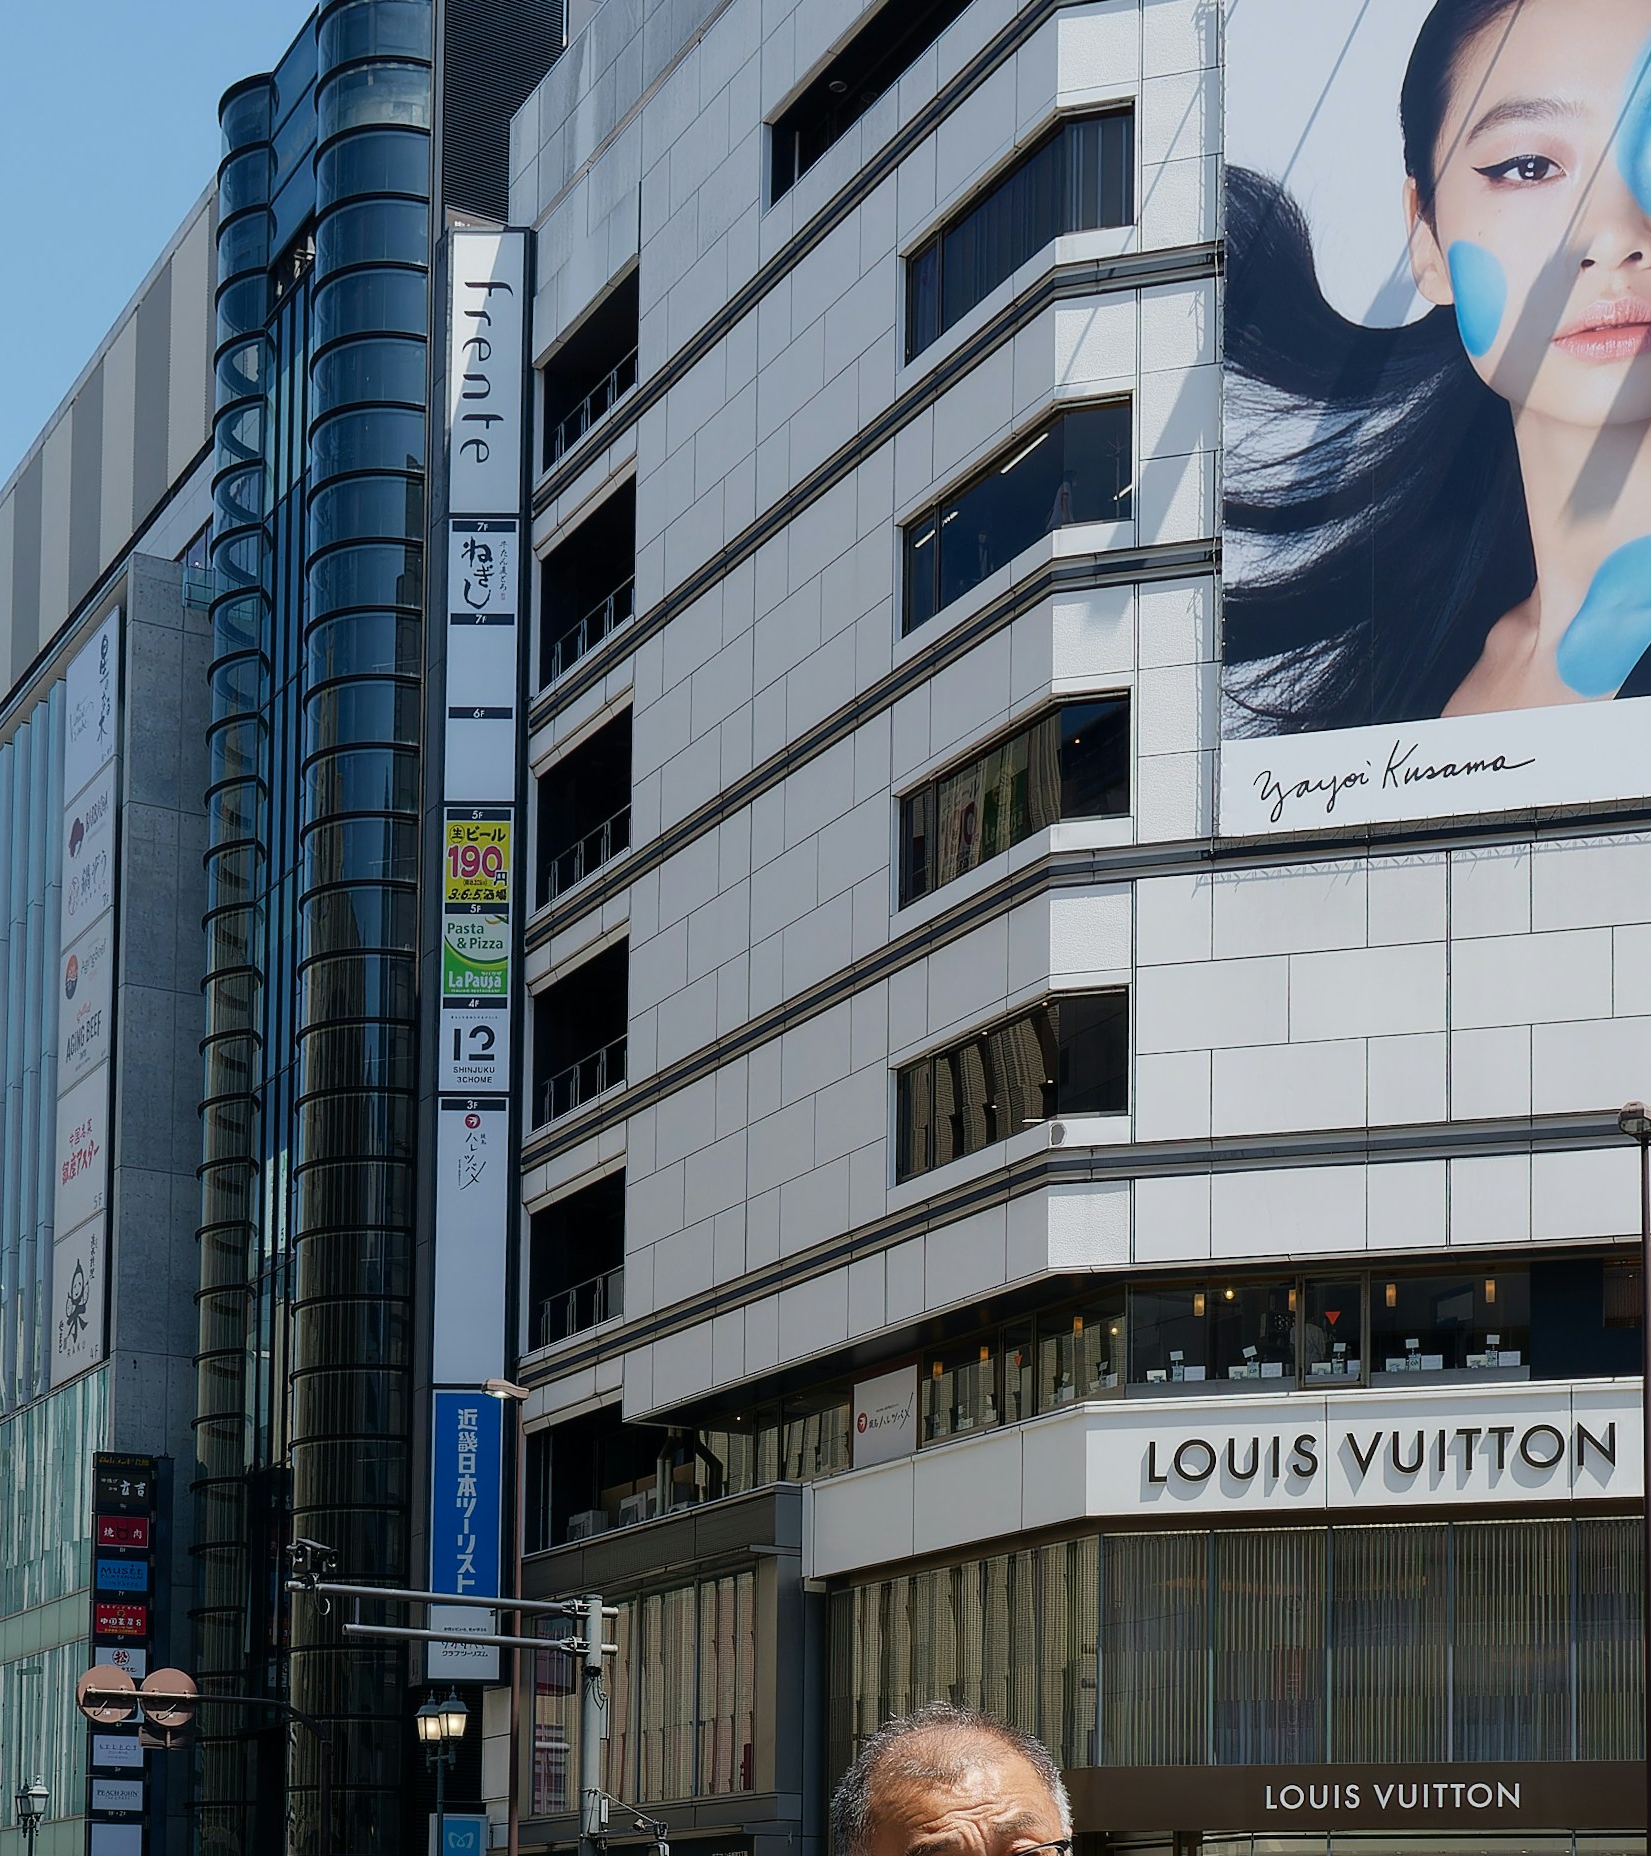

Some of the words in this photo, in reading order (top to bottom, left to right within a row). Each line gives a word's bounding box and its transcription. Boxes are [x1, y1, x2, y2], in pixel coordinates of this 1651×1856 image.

[459, 280, 514, 465] frente
[476, 522, 489, 531] 7F
[461, 536, 495, 610] ねぎし
[475, 614, 487, 624] 7F
[473, 707, 485, 718] 6F
[1381, 739, 1536, 791] Kusama
[471, 810, 484, 820] 5F
[469, 904, 482, 914] 5F
[447, 922, 485, 935] Pasta
[456, 937, 467, 949] &
[469, 937, 504, 950] Pizza
[468, 999, 480, 1008] 4F
[85, 1010, 102, 1046] BEEF
[453, 1025, 496, 1061] 12
[453, 1066, 495, 1074] SHINJUKU
[456, 1076, 492, 1084] 3CHOME
[466, 1100, 479, 1109] 3F
[1148, 1434, 1319, 1483] LOUIS
[1346, 1422, 1617, 1478] VUITTON
[456, 1408, 478, 1595] 近畿日本ツーリスト
[1265, 1784, 1360, 1810] LOUIS
[1373, 1782, 1521, 1809] VUITTON
